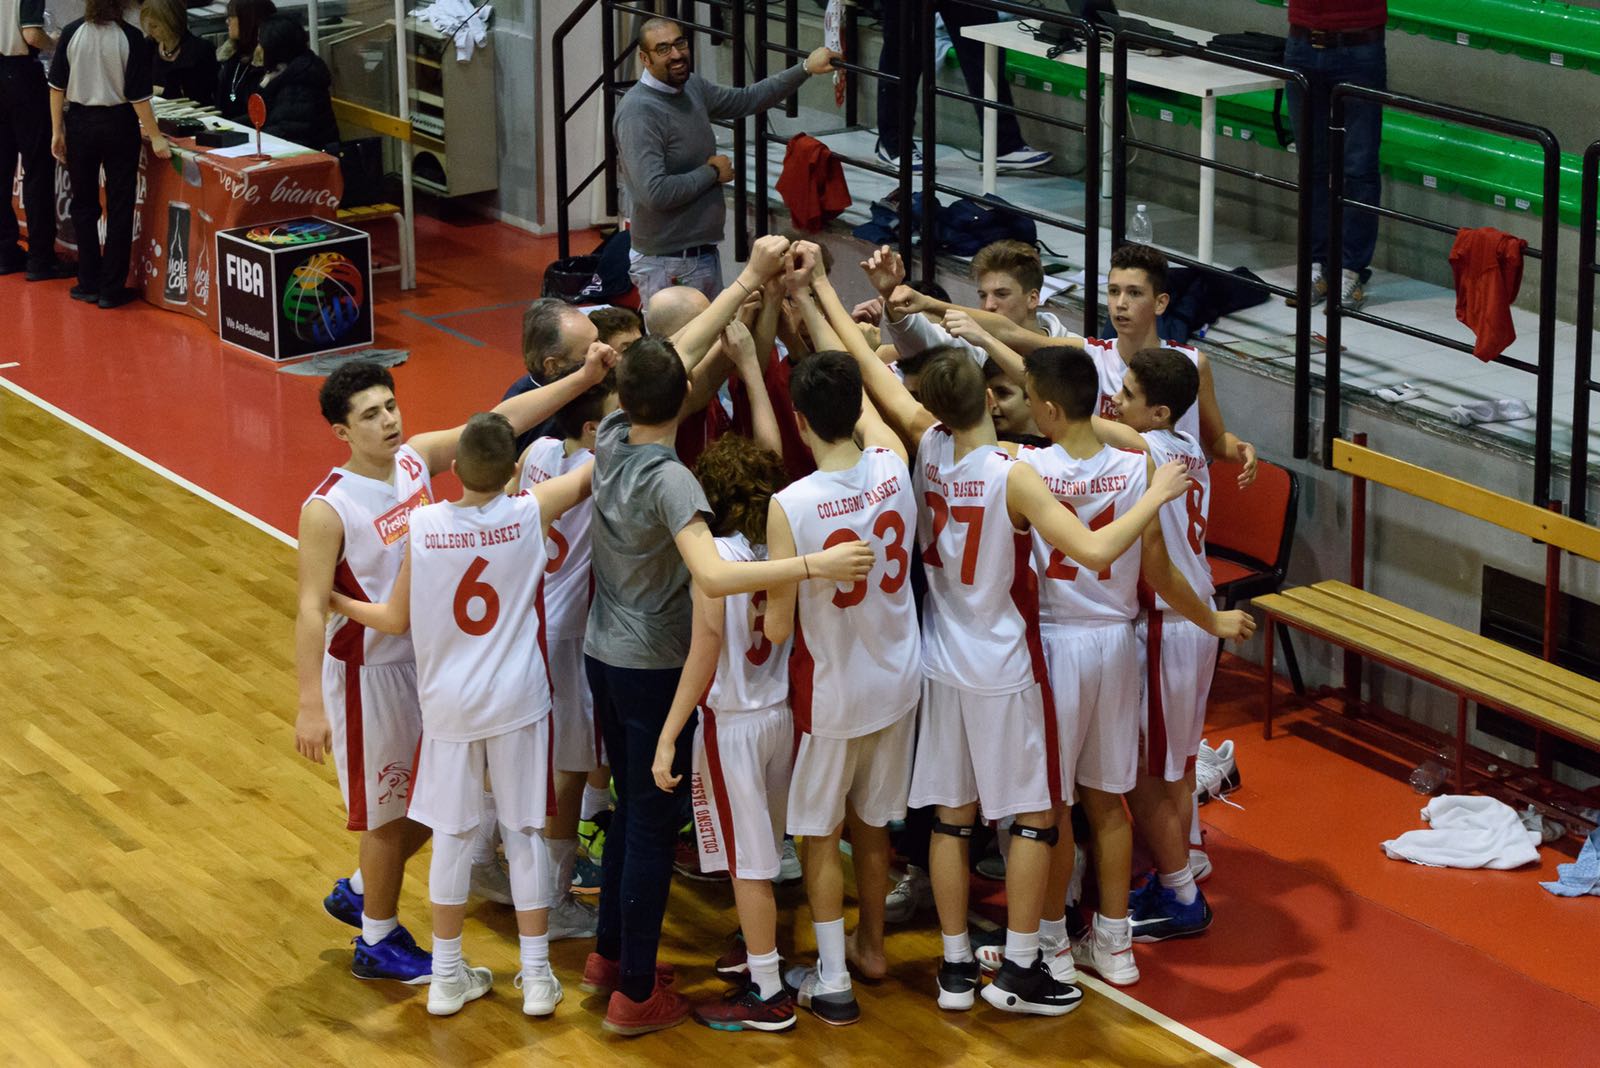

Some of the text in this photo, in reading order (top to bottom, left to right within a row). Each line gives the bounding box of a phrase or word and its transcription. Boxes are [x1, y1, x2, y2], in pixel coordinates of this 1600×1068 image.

[270, 175, 340, 209] bianca
[226, 253, 265, 298] FIBA
[226, 316, 270, 342] We Are Basketball
[817, 476, 901, 519] COLLEGNO BASKET
[953, 480, 985, 497] BASKET
[1090, 475, 1127, 494] BASKET
[424, 532, 476, 550] COLLEGNO
[479, 522, 521, 547] BASKET
[921, 491, 985, 586] 27
[453, 556, 500, 636] 6
[695, 809, 720, 854] COLLEGNO
